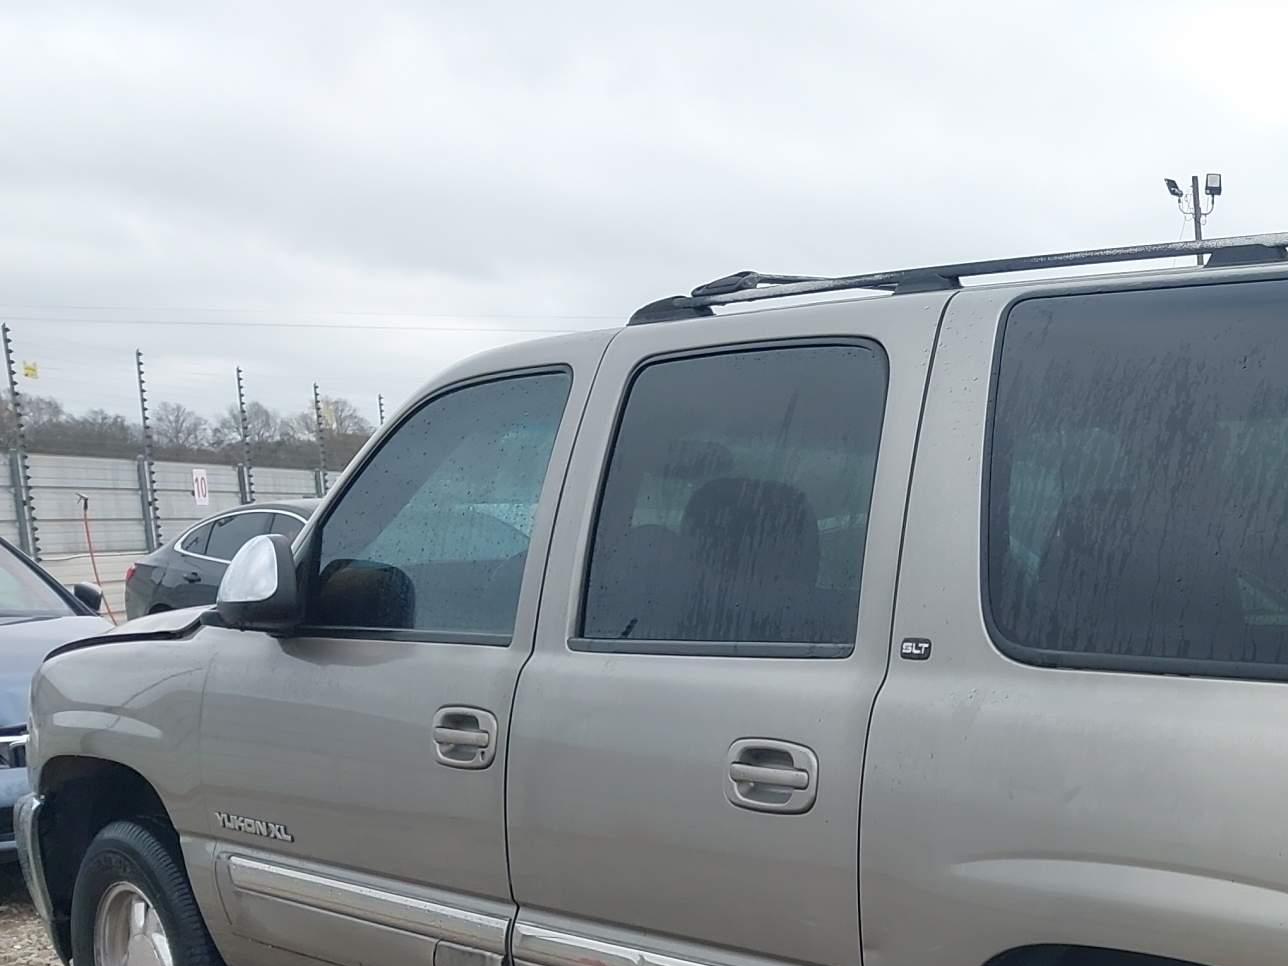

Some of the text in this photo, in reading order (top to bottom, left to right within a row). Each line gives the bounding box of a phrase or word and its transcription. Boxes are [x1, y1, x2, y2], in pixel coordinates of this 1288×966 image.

[195, 476, 207, 498] 10
[902, 642, 929, 655] SLT
[214, 811, 294, 842] YUKON XL
